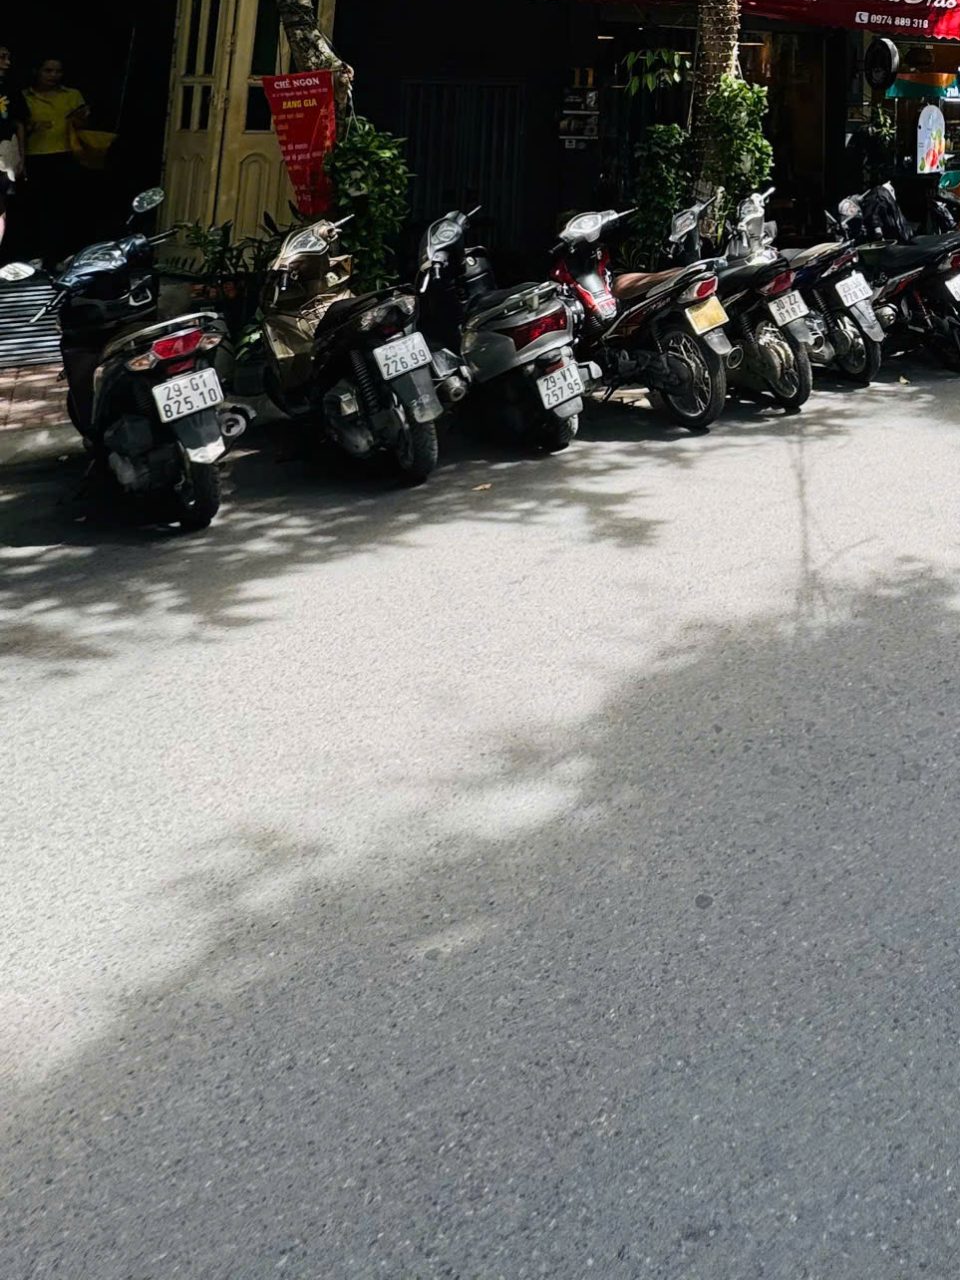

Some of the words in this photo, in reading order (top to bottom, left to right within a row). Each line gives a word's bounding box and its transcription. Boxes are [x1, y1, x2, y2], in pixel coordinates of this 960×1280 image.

[870, 14, 893, 25] 0974
[894, 16, 911, 27] 889
[292, 77, 320, 88] NGON
[163, 374, 207, 401] 29-G1
[543, 367, 573, 391] 29-V1
[163, 387, 218, 419] 825.10
